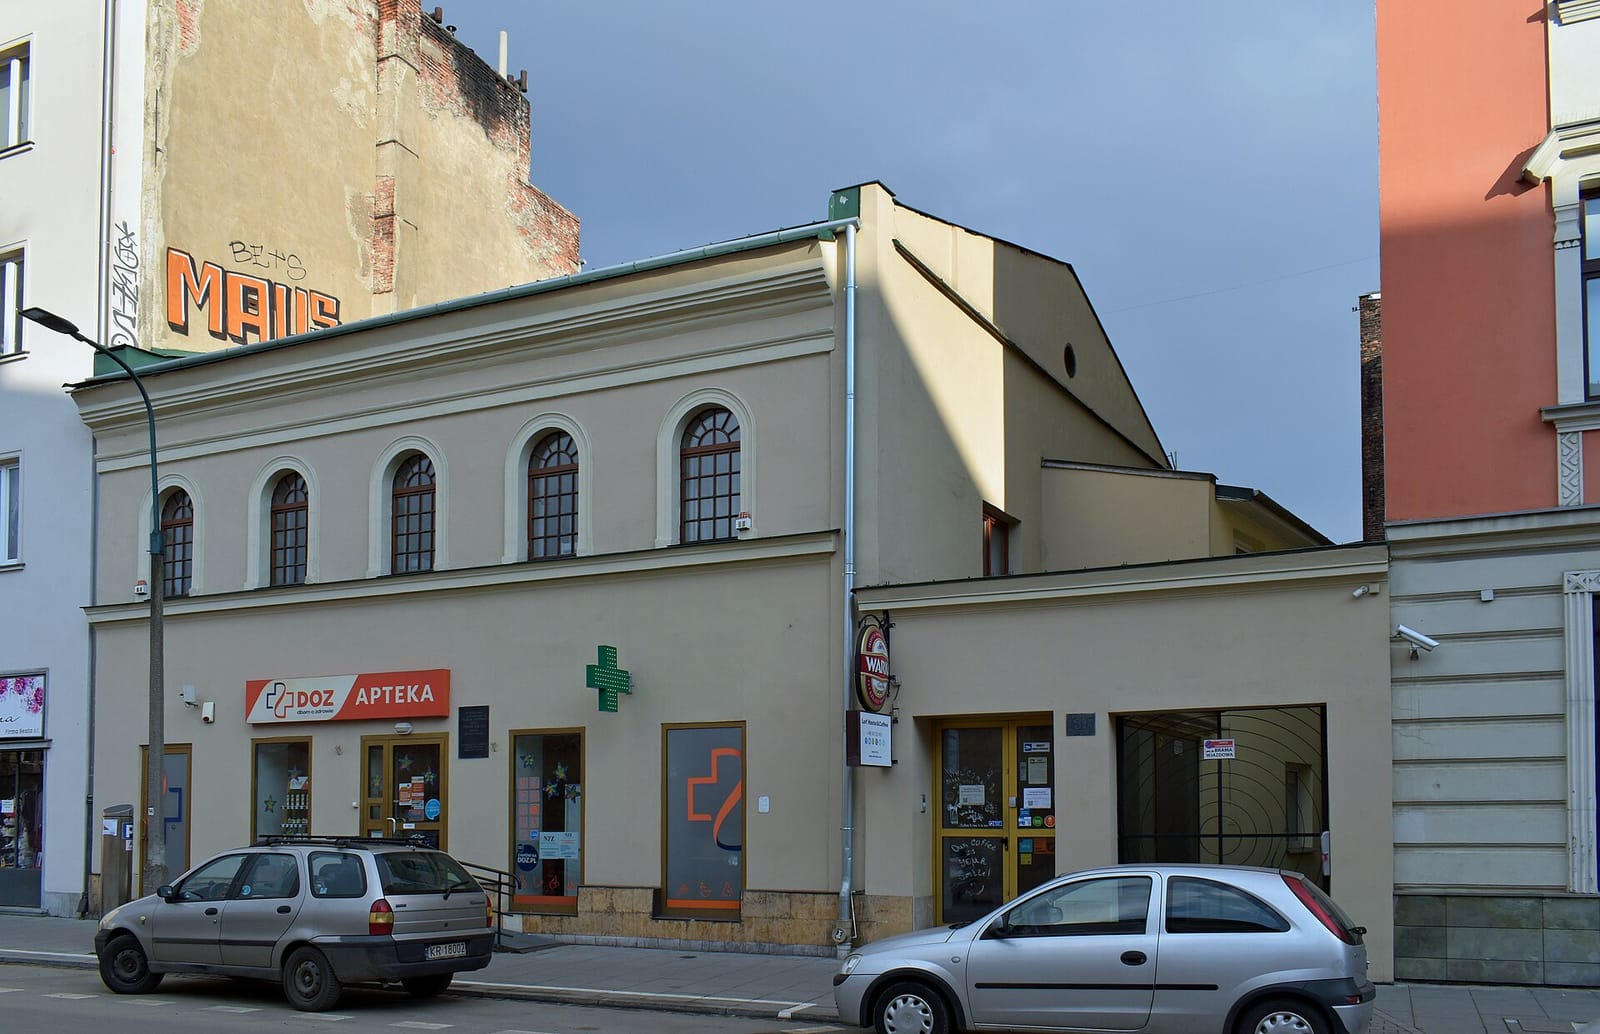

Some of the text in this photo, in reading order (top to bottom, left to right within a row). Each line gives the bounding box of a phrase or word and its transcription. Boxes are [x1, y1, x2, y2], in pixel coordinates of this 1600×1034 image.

[167, 246, 343, 346] MAUS
[297, 689, 335, 708] DOZ
[355, 683, 435, 706] APTEKA
[429, 943, 465, 957] KR 18002
